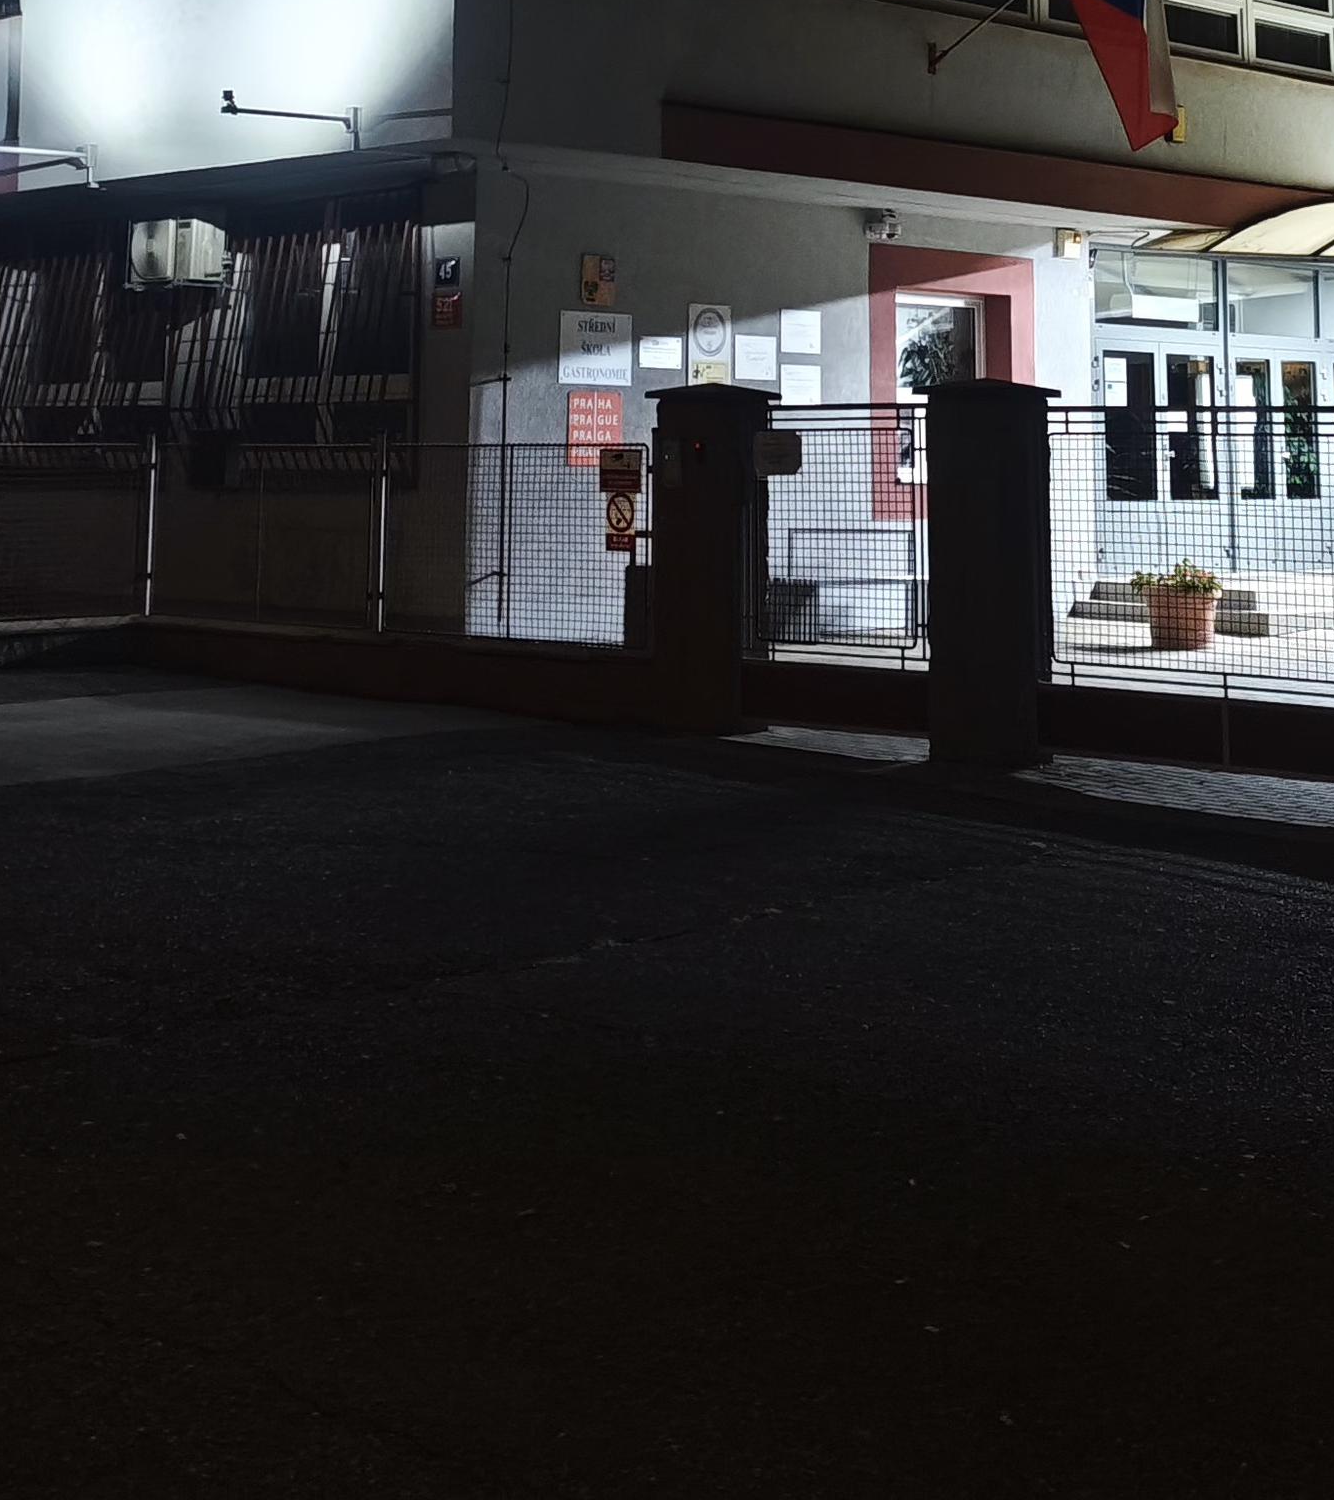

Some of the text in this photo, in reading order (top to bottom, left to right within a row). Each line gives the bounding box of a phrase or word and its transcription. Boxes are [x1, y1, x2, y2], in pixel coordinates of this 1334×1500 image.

[438, 262, 453, 280] 45
[577, 317, 616, 334] STŘEDNÍ
[580, 339, 611, 356] ŠKOLA
[563, 365, 628, 382] GASTRONOMIE
